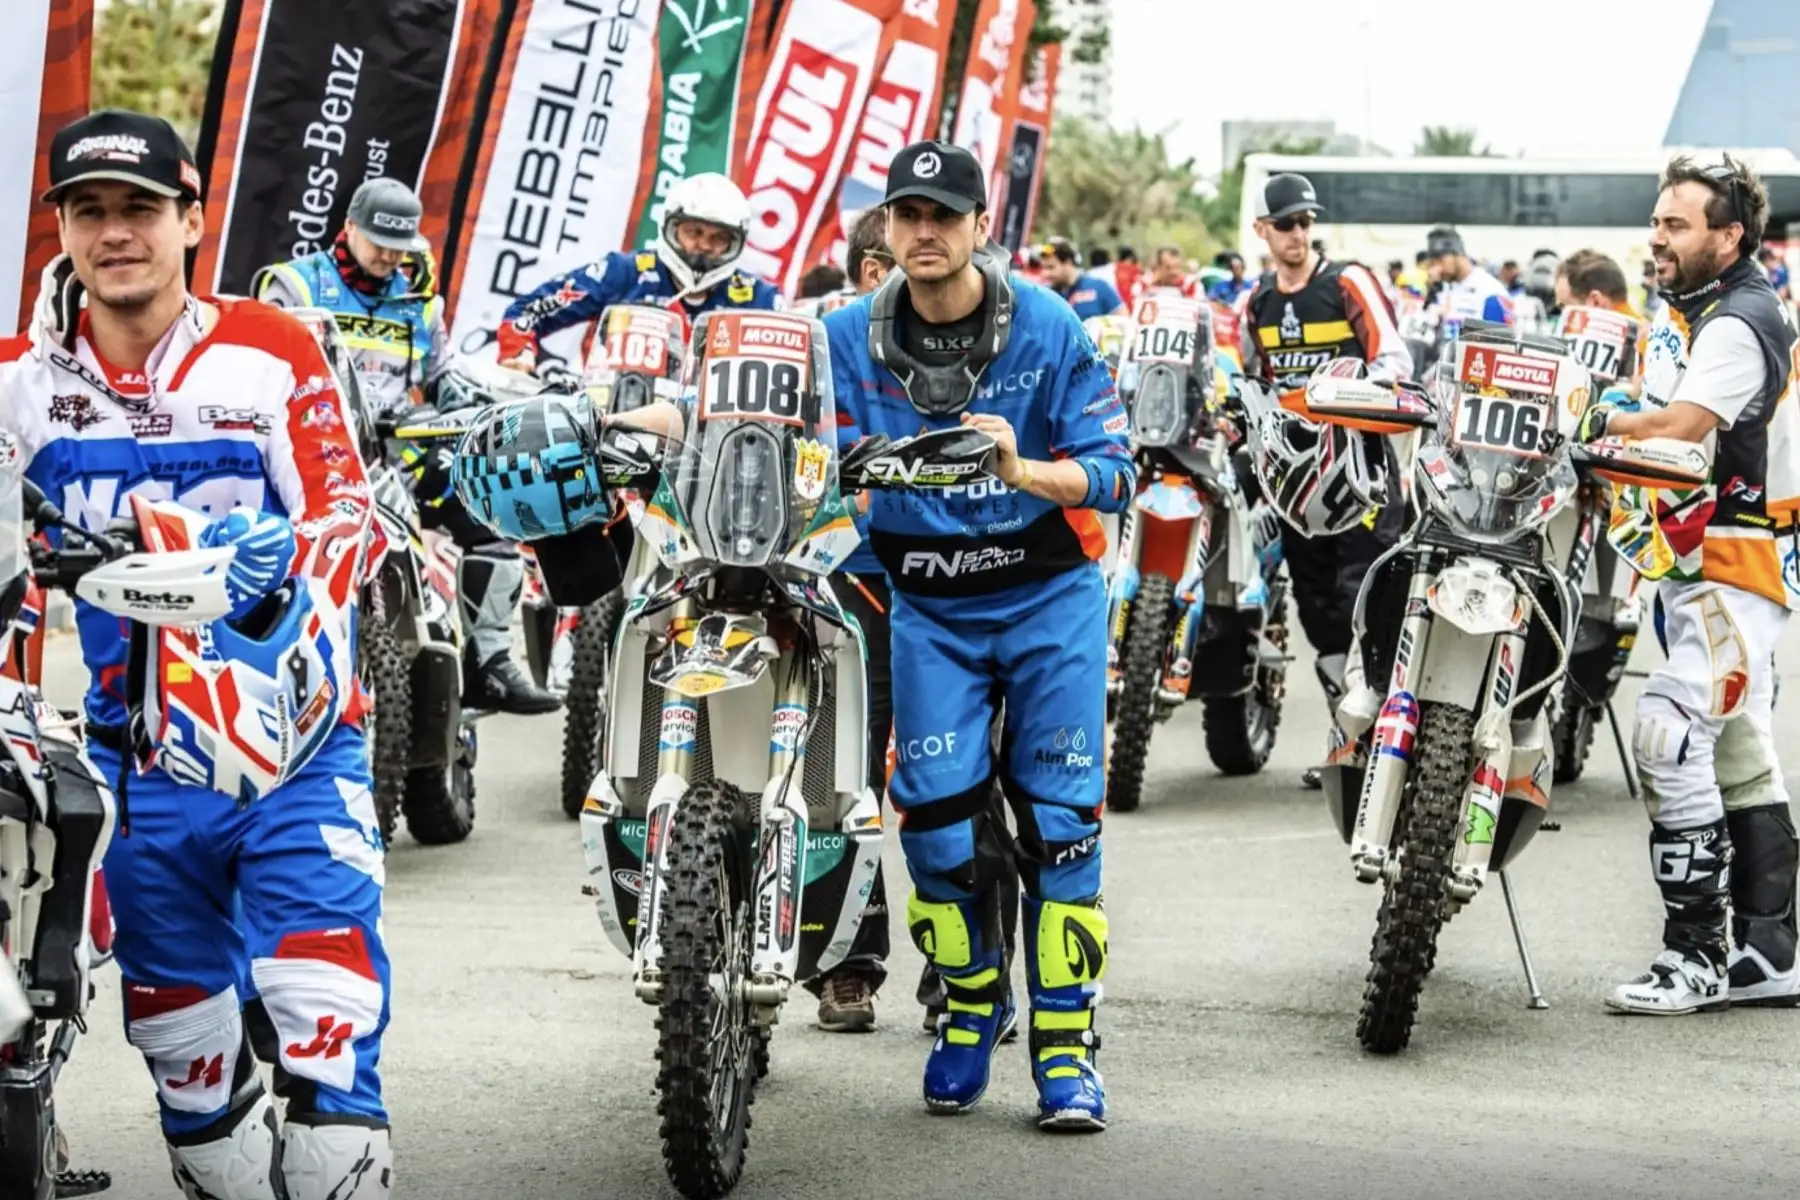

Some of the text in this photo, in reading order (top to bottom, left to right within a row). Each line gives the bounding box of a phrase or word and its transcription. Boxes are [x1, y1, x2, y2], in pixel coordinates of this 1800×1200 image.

[66, 134, 150, 161] ORIGINAL
[606, 331, 664, 369] 103
[743, 327, 804, 348] MOTUL
[1138, 328, 1189, 359] 104
[1496, 364, 1550, 383] MOTUL
[710, 359, 800, 417] 108
[1460, 397, 1540, 451] 106
[858, 456, 924, 484] FN
[901, 551, 963, 578] FN
[122, 588, 195, 604] Beta
[757, 894, 772, 951] LMR
